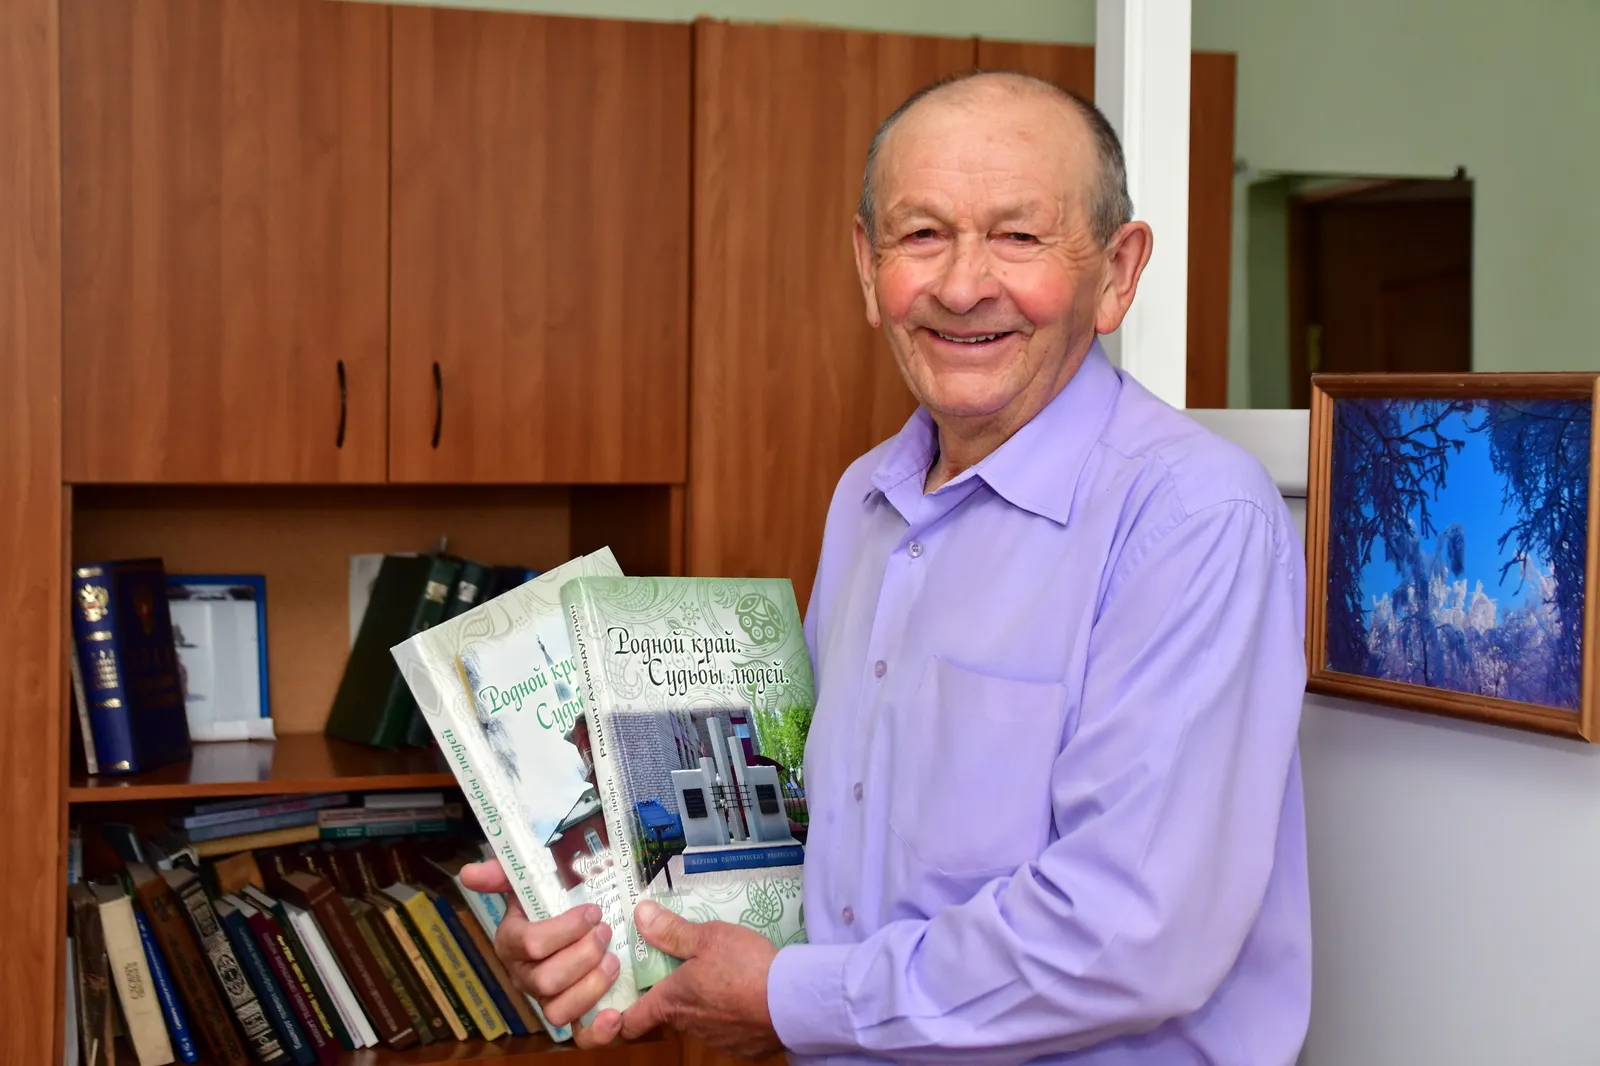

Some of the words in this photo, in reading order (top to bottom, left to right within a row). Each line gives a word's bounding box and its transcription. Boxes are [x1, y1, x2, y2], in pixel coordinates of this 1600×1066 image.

[569, 604, 596, 702] Ахмадуллин
[607, 626, 685, 664] Родной
[691, 630, 741, 664] край.
[479, 664, 548, 715] Родной
[649, 658, 724, 696] Судьбы
[730, 661, 790, 694] людей.
[440, 728, 473, 773] людей
[591, 706, 607, 758] Рашит
[469, 777, 503, 837] Судьбы
[606, 775, 620, 816] людей.
[501, 840, 526, 886] край.
[614, 819, 632, 868] Судьбы
[624, 872, 639, 906] край.
